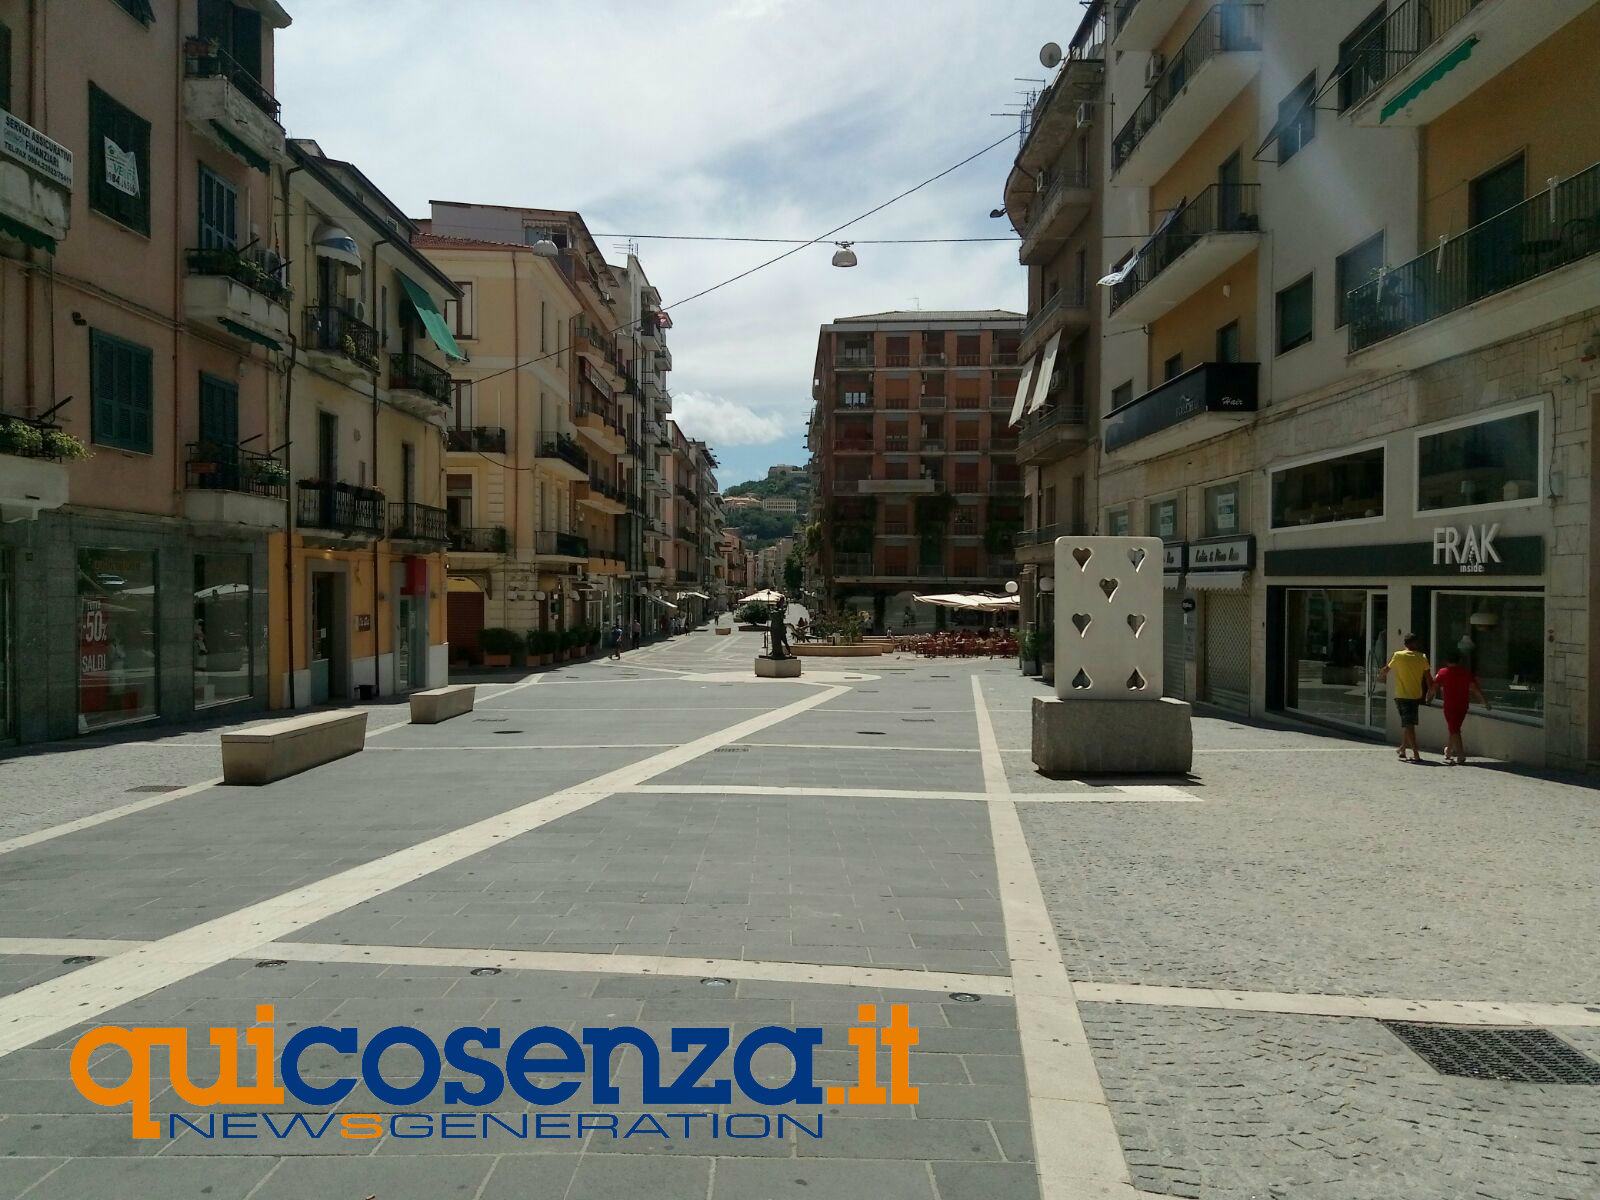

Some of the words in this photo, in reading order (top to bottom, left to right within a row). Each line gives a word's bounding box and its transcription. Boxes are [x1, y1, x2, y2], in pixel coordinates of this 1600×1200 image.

[6, 116, 31, 137] SERVIZI
[32, 132, 72, 163] ASSICURATIVI
[25, 140, 59, 168] FINANZIARI
[1433, 523, 1503, 564] FRAK
[1460, 561, 1485, 573] inside
[82, 610, 108, 641] -50%
